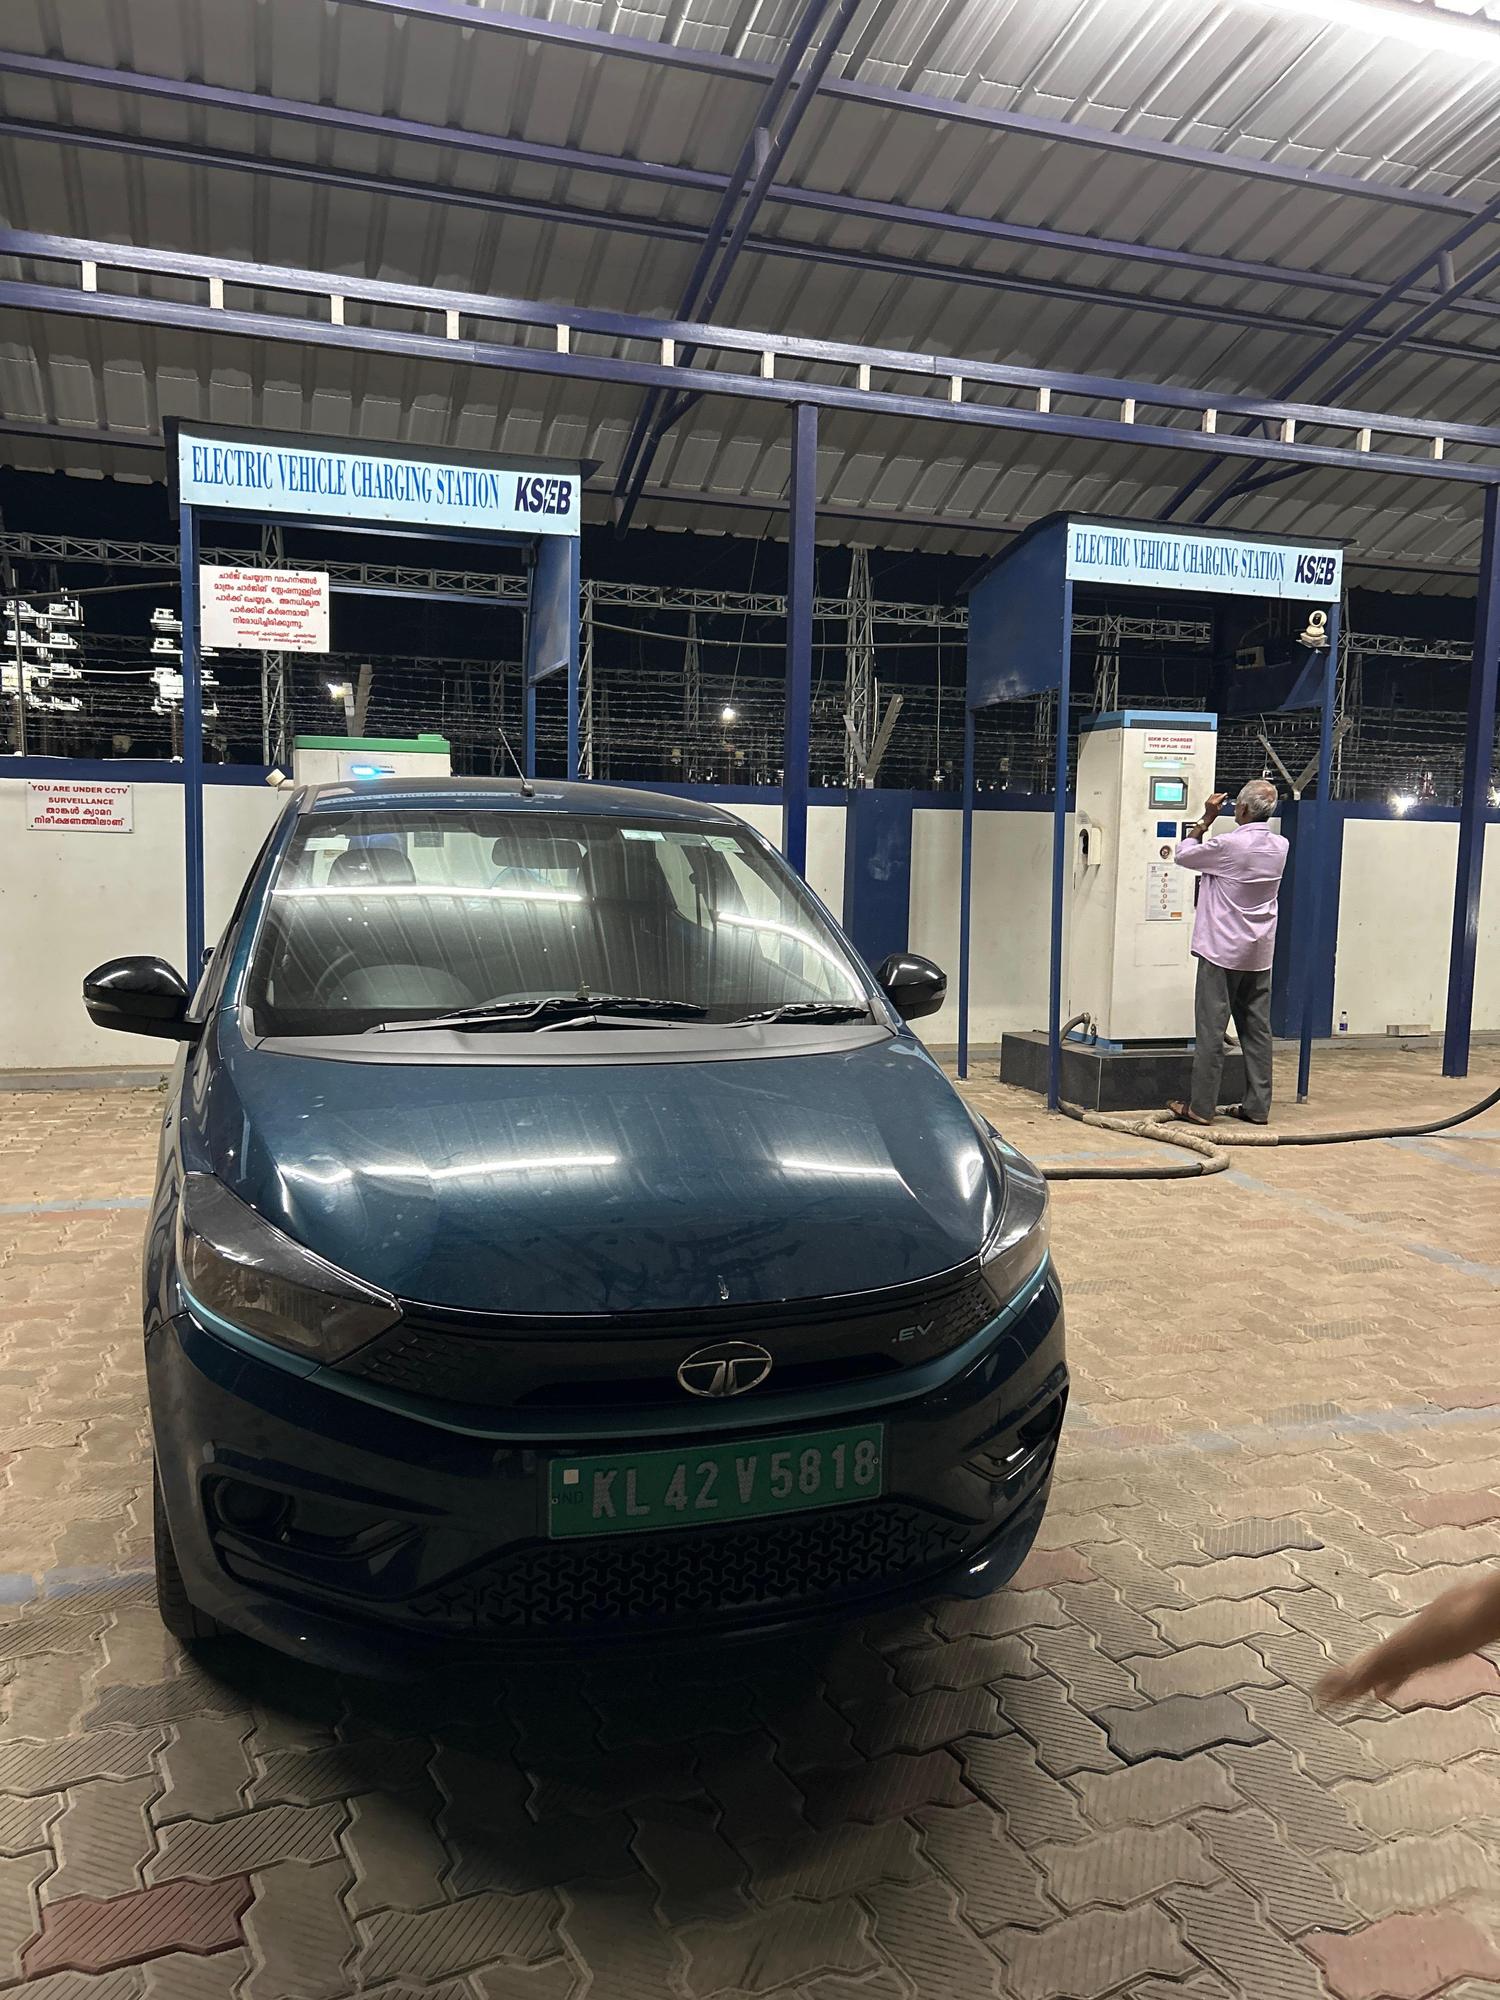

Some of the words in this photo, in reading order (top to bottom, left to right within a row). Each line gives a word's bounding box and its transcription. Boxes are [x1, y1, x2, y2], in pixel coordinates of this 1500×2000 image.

[192, 445, 273, 489] ELECTRIC
[277, 454, 347, 495] VEHICLE
[352, 461, 433, 503] CHARGING
[436, 469, 499, 509] STATION
[514, 476, 572, 516] KSEB
[1075, 533, 1131, 567] ELECTRIC
[1133, 538, 1181, 572] VEHICLE
[1183, 543, 1239, 578] CHARGING
[1241, 549, 1286, 581] STATION
[1294, 554, 1336, 586] KSEB
[32, 784, 50, 792] YOU
[52, 785, 70, 793] ARE
[73, 786, 102, 794] UNDER
[104, 787, 128, 795] CCTV
[48, 796, 114, 805] SURVEILLANCE
[592, 1468, 650, 1519] KL
[663, 1461, 719, 1511] 42
[735, 1455, 757, 1504] V
[770, 1439, 875, 1498] 5818
